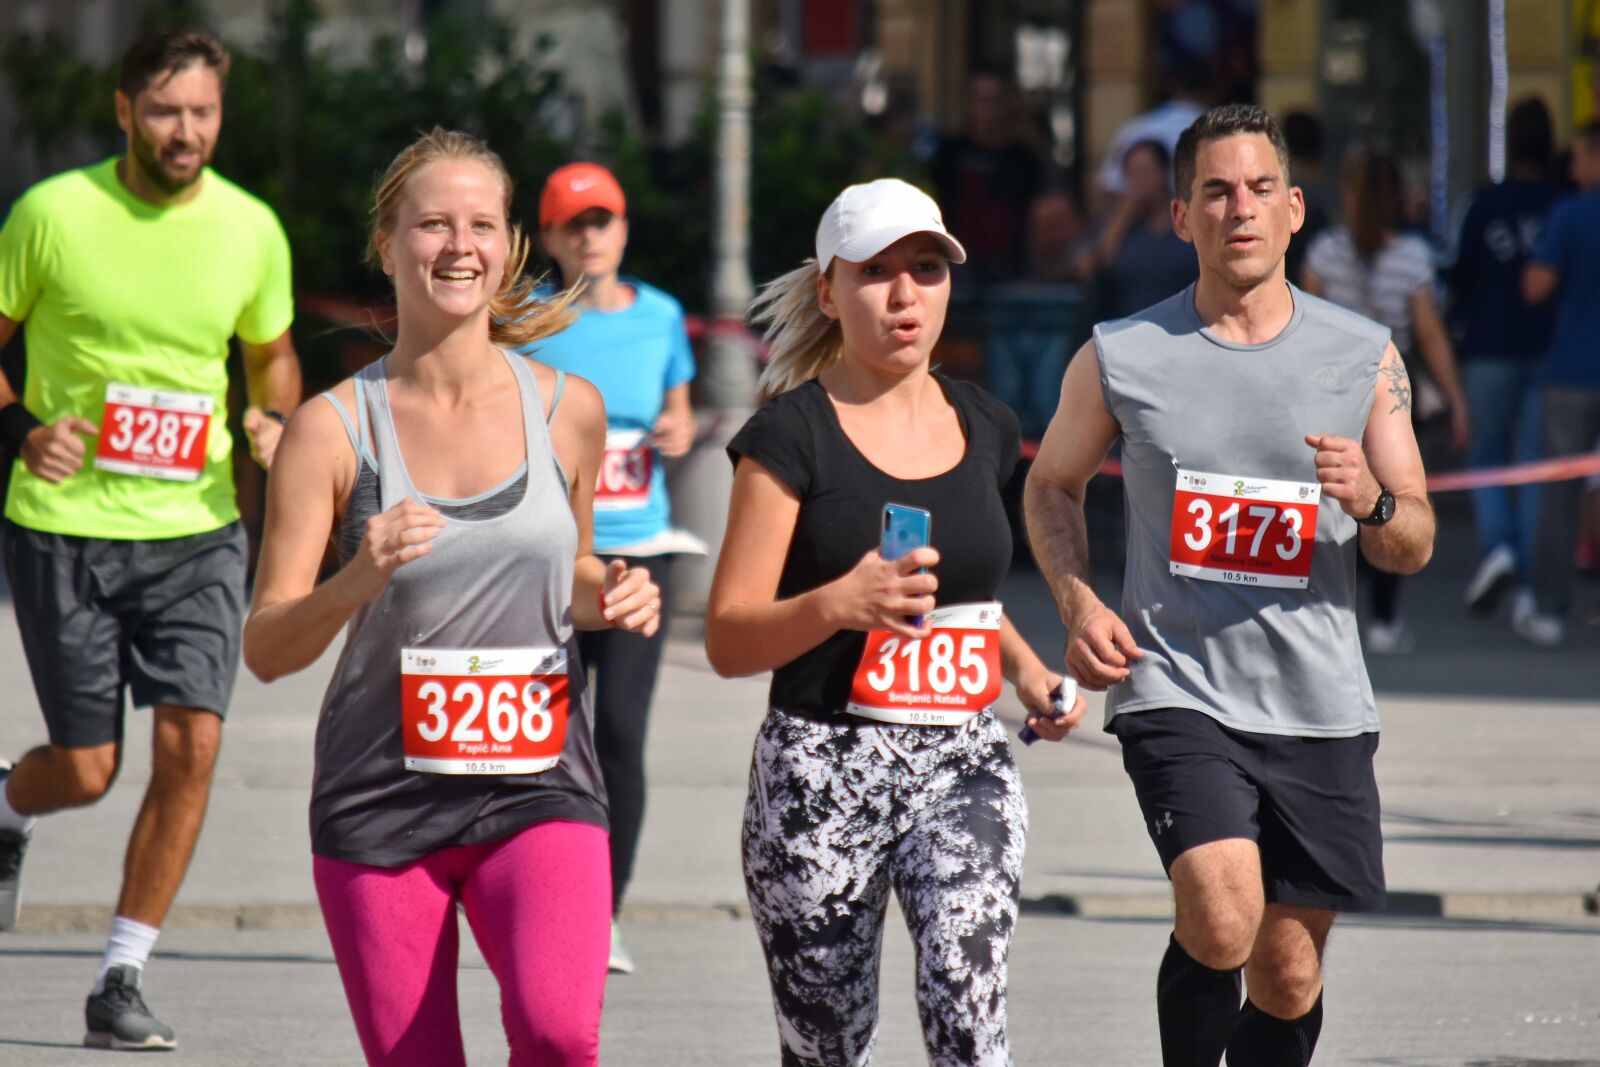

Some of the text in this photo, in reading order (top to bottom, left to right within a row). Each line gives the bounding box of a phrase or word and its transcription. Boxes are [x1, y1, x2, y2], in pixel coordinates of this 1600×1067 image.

[109, 406, 204, 460] 3287
[1184, 498, 1303, 560] 3173
[1222, 572, 1258, 582] 10.5 km
[867, 633, 988, 694] 3185
[416, 681, 553, 743] 3268
[910, 713, 945, 722] 10.5 km
[458, 743, 513, 756] Papić Ana
[465, 763, 506, 772] 10.5 km
